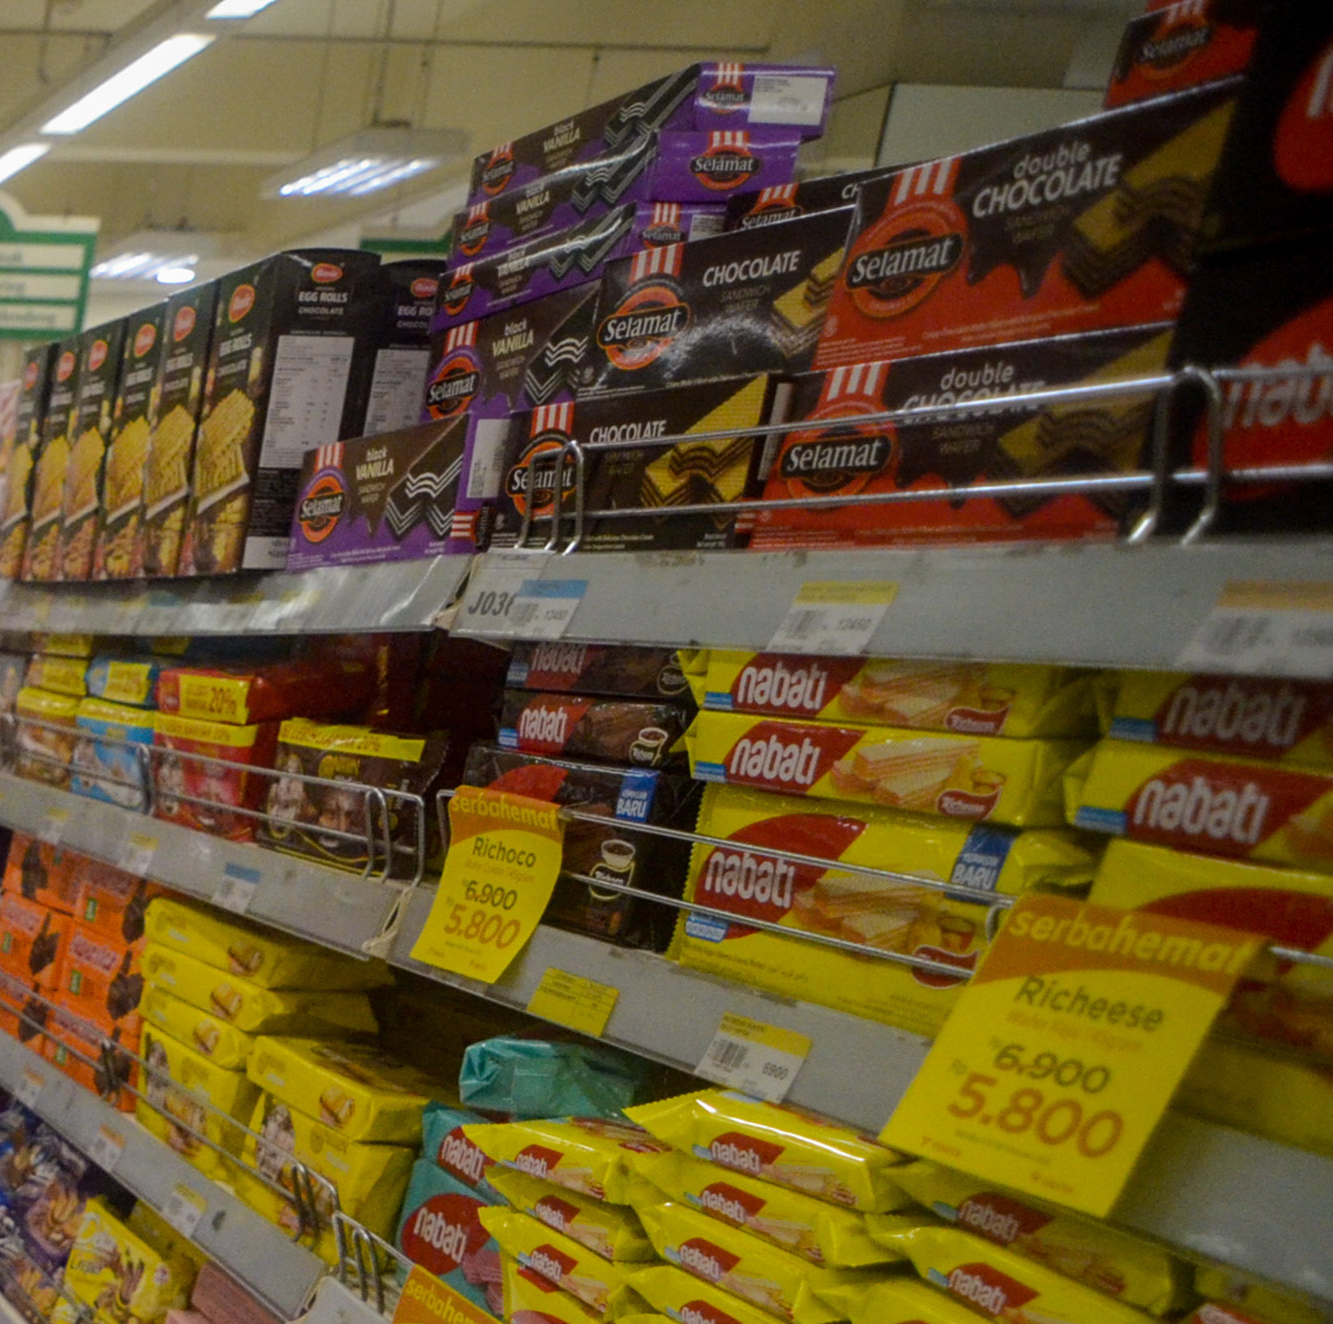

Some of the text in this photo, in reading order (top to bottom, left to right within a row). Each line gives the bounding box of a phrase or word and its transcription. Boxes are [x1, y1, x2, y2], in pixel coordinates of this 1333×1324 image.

[694, 156, 754, 172] Selamat
[1014, 141, 1092, 178] double
[973, 154, 1124, 219] CHOCOLATE
[703, 250, 801, 288] CHOCOLATE
[852, 238, 954, 283] Selamat
[299, 291, 320, 304] EGG
[493, 328, 533, 358] VANILLA
[606, 309, 681, 342] Selamat
[430, 371, 478, 403] Selamat
[941, 360, 1014, 390] double
[355, 457, 395, 481] VANILLA
[786, 438, 881, 472] Selamat
[299, 492, 344, 518] Selamat
[737, 664, 827, 712] nabati
[519, 707, 568, 743] nabati
[1163, 683, 1307, 748] nabati
[730, 736, 821, 785] nabati
[616, 797, 647, 818] BARU
[1134, 777, 1268, 846] nabati
[472, 837, 536, 869] Richoco
[705, 851, 796, 908] nabati
[954, 859, 998, 891] BARU
[465, 880, 517, 910] 6.900
[444, 904, 522, 949] 5.800
[1009, 908, 1253, 975] serbahemat
[1017, 976, 1165, 1033] Richeese
[994, 1044, 1111, 1095] 6.900
[947, 1072, 1124, 1158] 5.800
[441, 1136, 485, 1181] nabati
[700, 1186, 746, 1224] nabati
[959, 1199, 1020, 1242] nabati
[414, 1206, 467, 1265] nabati
[948, 1268, 1008, 1317] nabati
